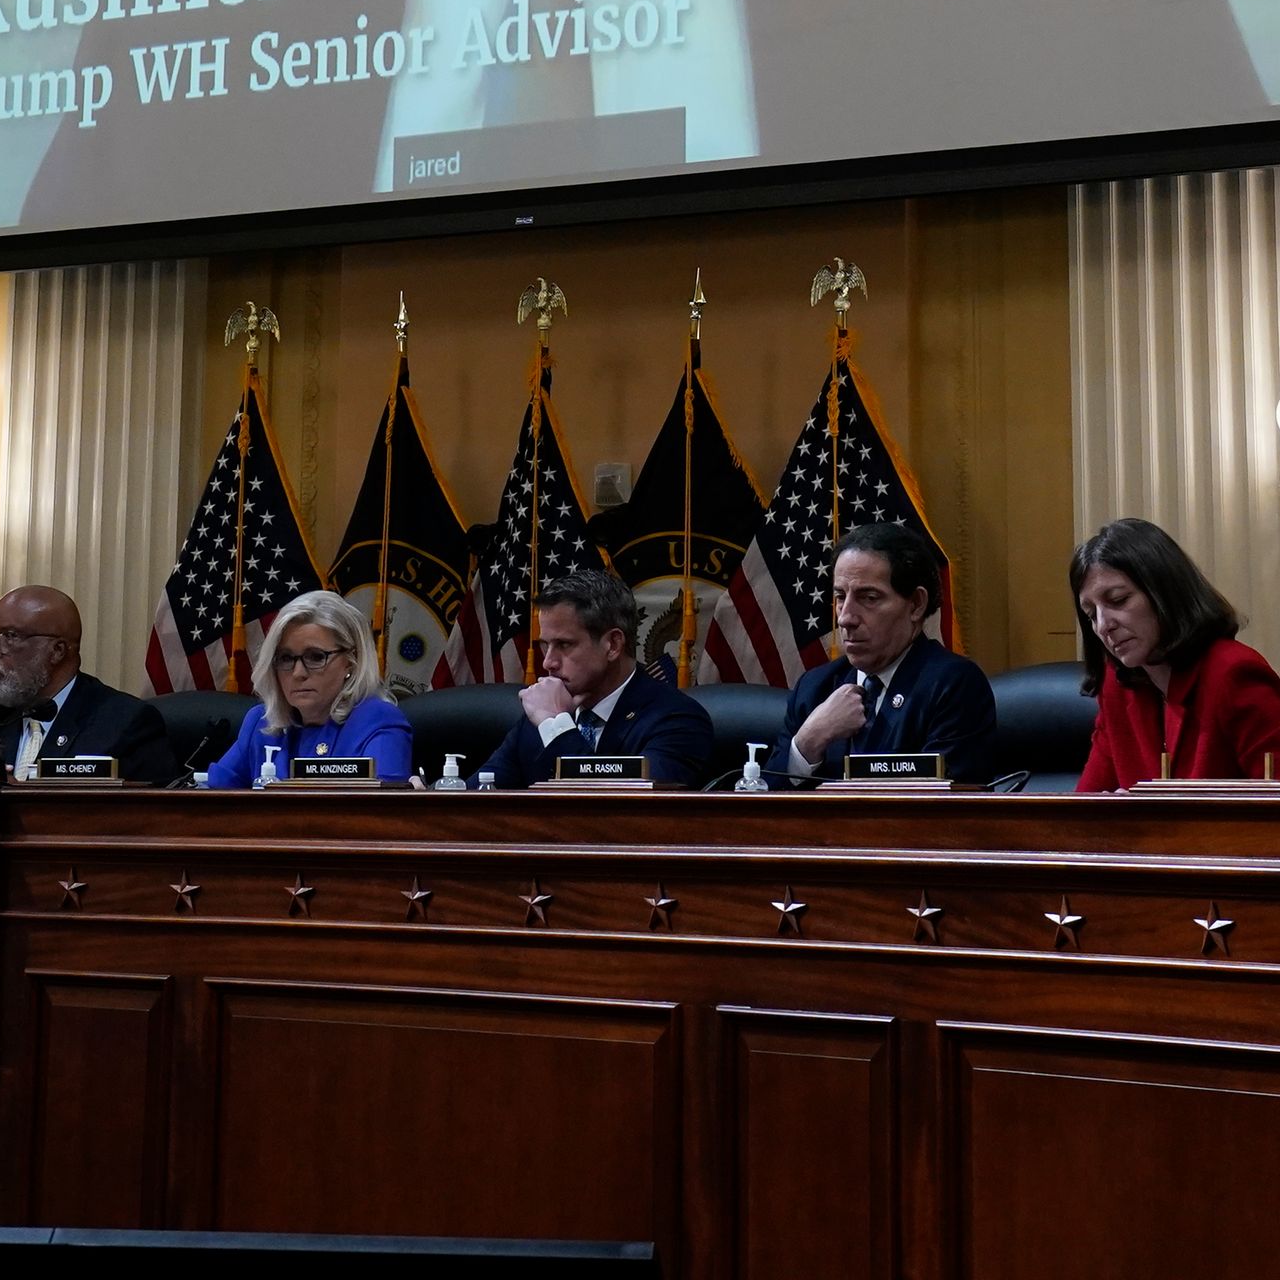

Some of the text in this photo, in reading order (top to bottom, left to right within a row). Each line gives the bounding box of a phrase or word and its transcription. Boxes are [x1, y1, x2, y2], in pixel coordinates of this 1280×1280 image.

[129, 36, 230, 105] WH
[248, 13, 435, 93] Senior
[408, 150, 461, 184] jared
[55, 763, 97, 774] MS. CHENEY
[305, 763, 358, 774] MR. KINZINGER
[579, 763, 623, 774] MR. RASKIN
[870, 761, 916, 773] MRS. LURIA
